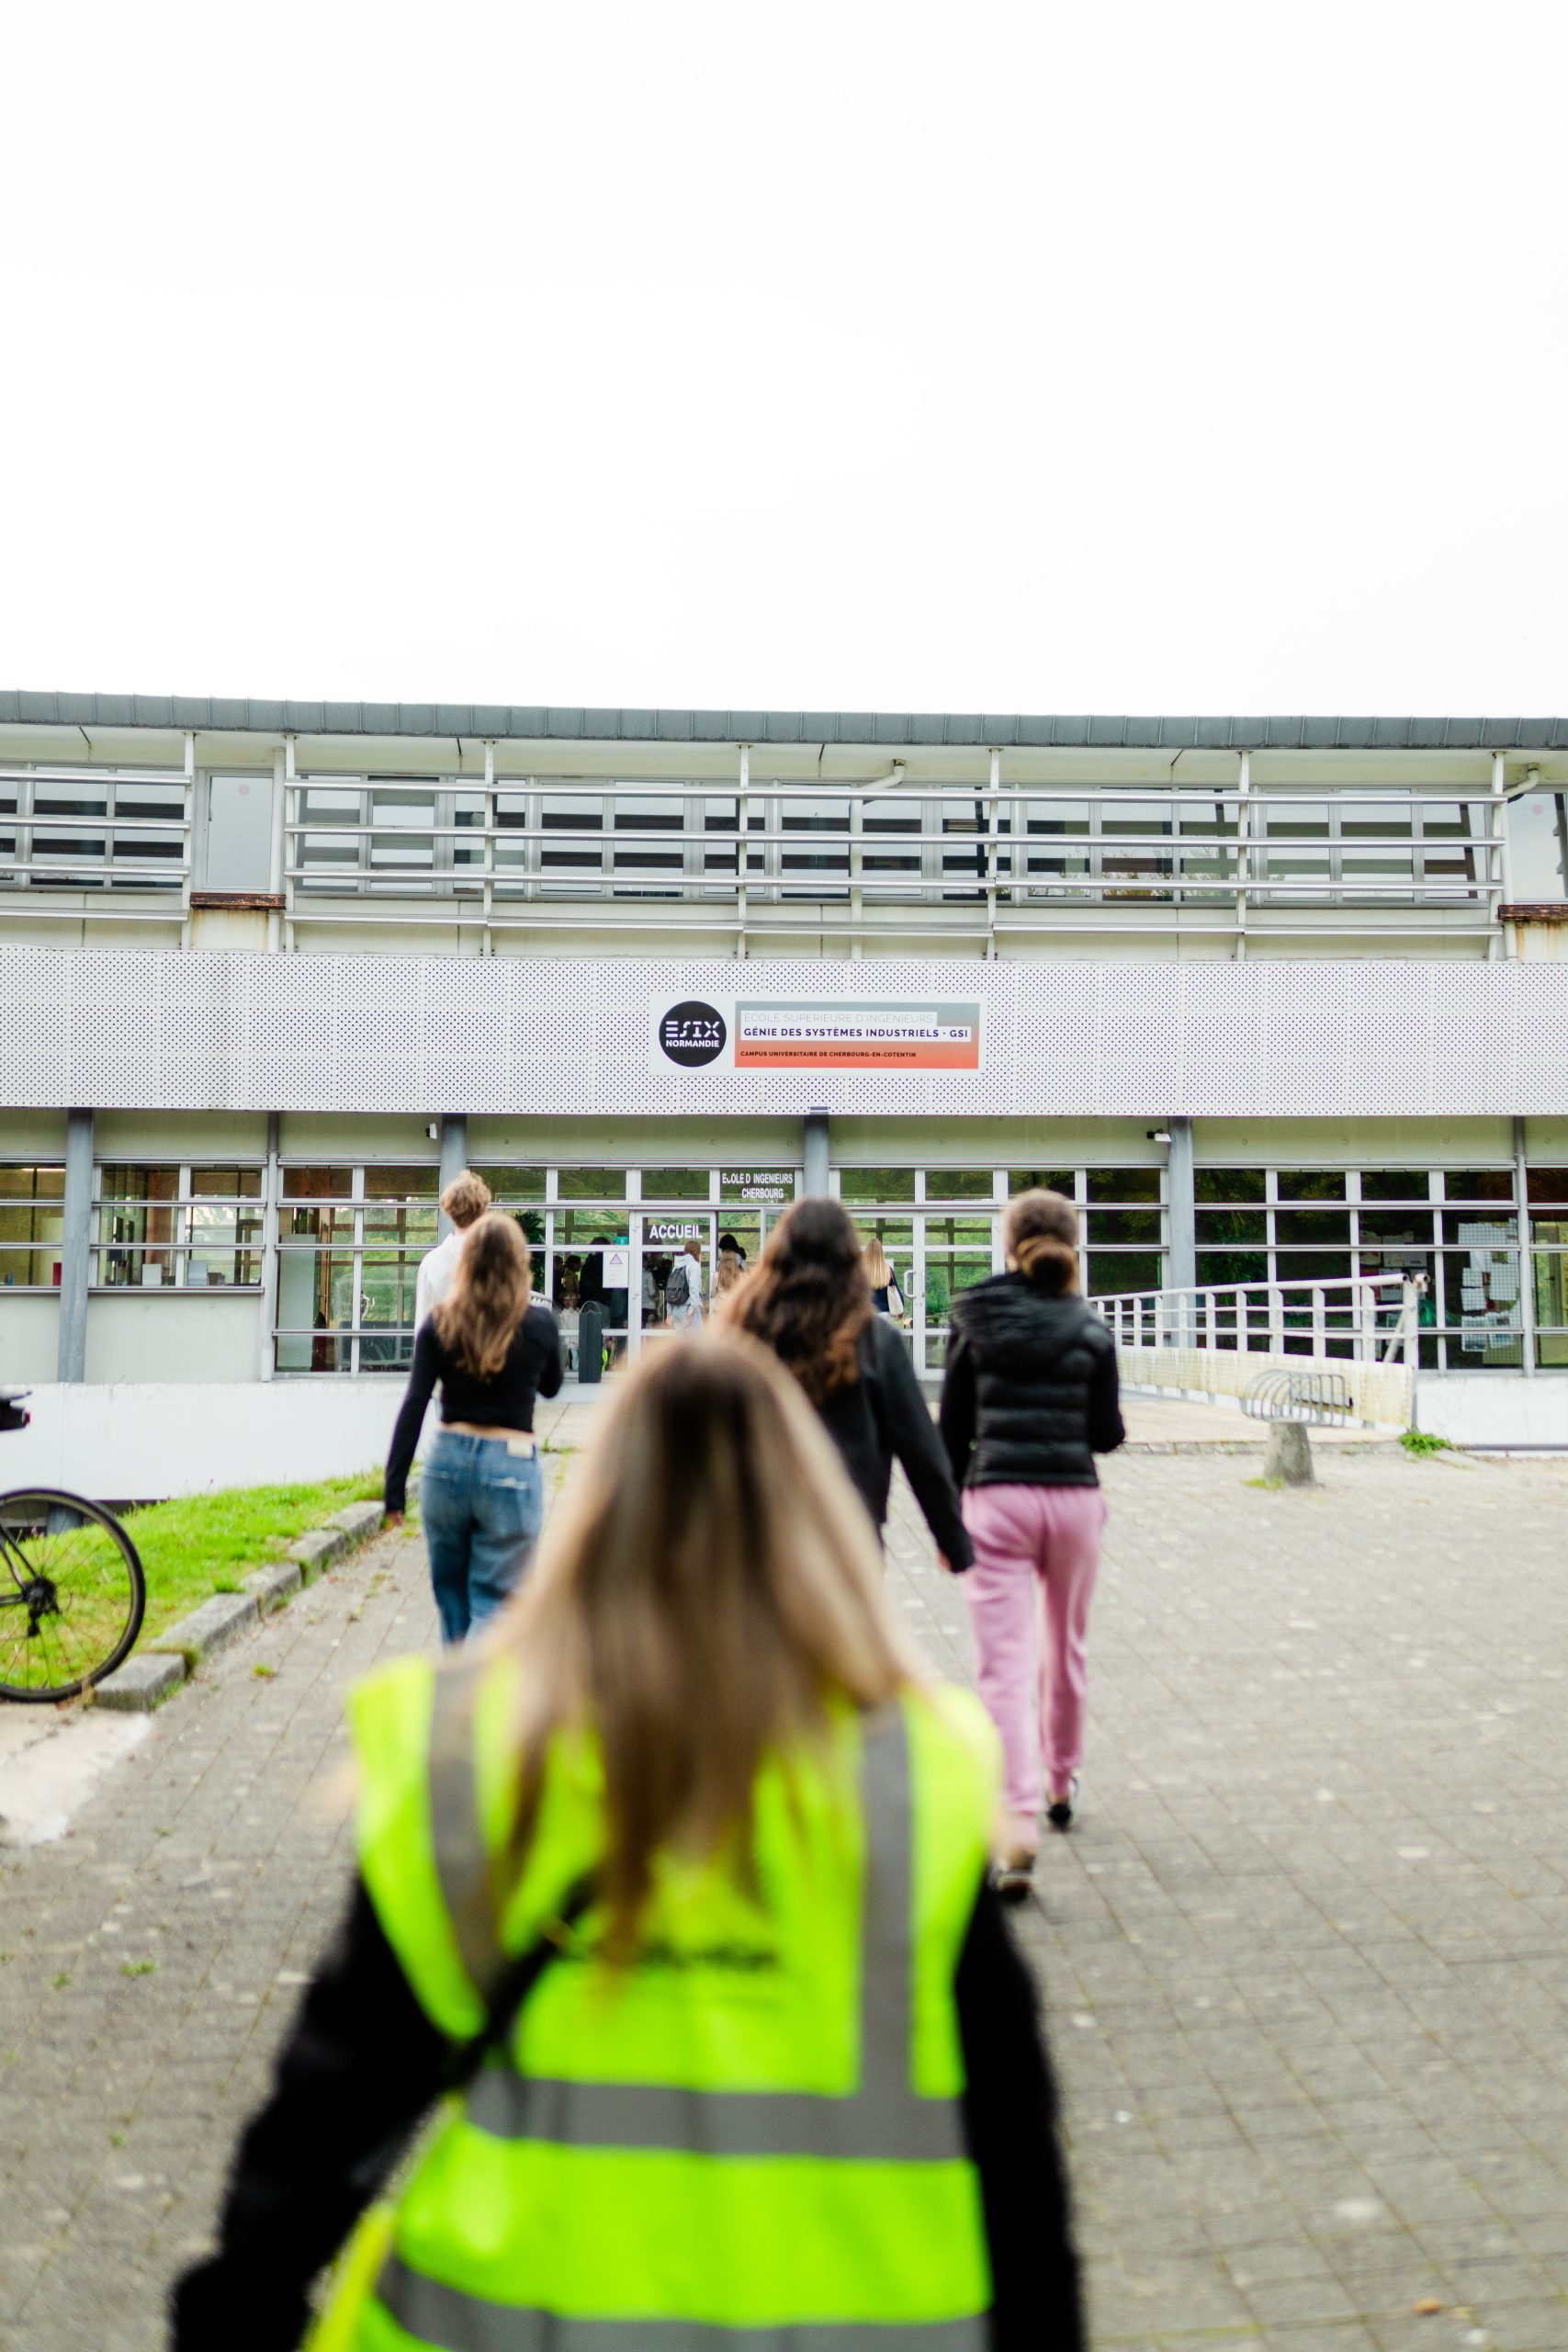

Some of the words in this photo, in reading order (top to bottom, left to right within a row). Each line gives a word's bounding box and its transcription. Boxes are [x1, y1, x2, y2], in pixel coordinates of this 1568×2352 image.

[665, 1021, 720, 1038] ESIX
[744, 1026, 777, 1036] GÉNIE
[781, 1028, 802, 1036] DES
[805, 1026, 863, 1037] SYSTÈMES
[865, 1029, 939, 1037] INDUSTRIELS
[950, 1029, 968, 1038] GSI
[665, 1039, 720, 1047] NORMANDIE
[753, 1172, 794, 1184] INGENIEURS
[741, 1187, 784, 1199] CHERBOURG
[649, 1225, 704, 1239] ACCUEIL
